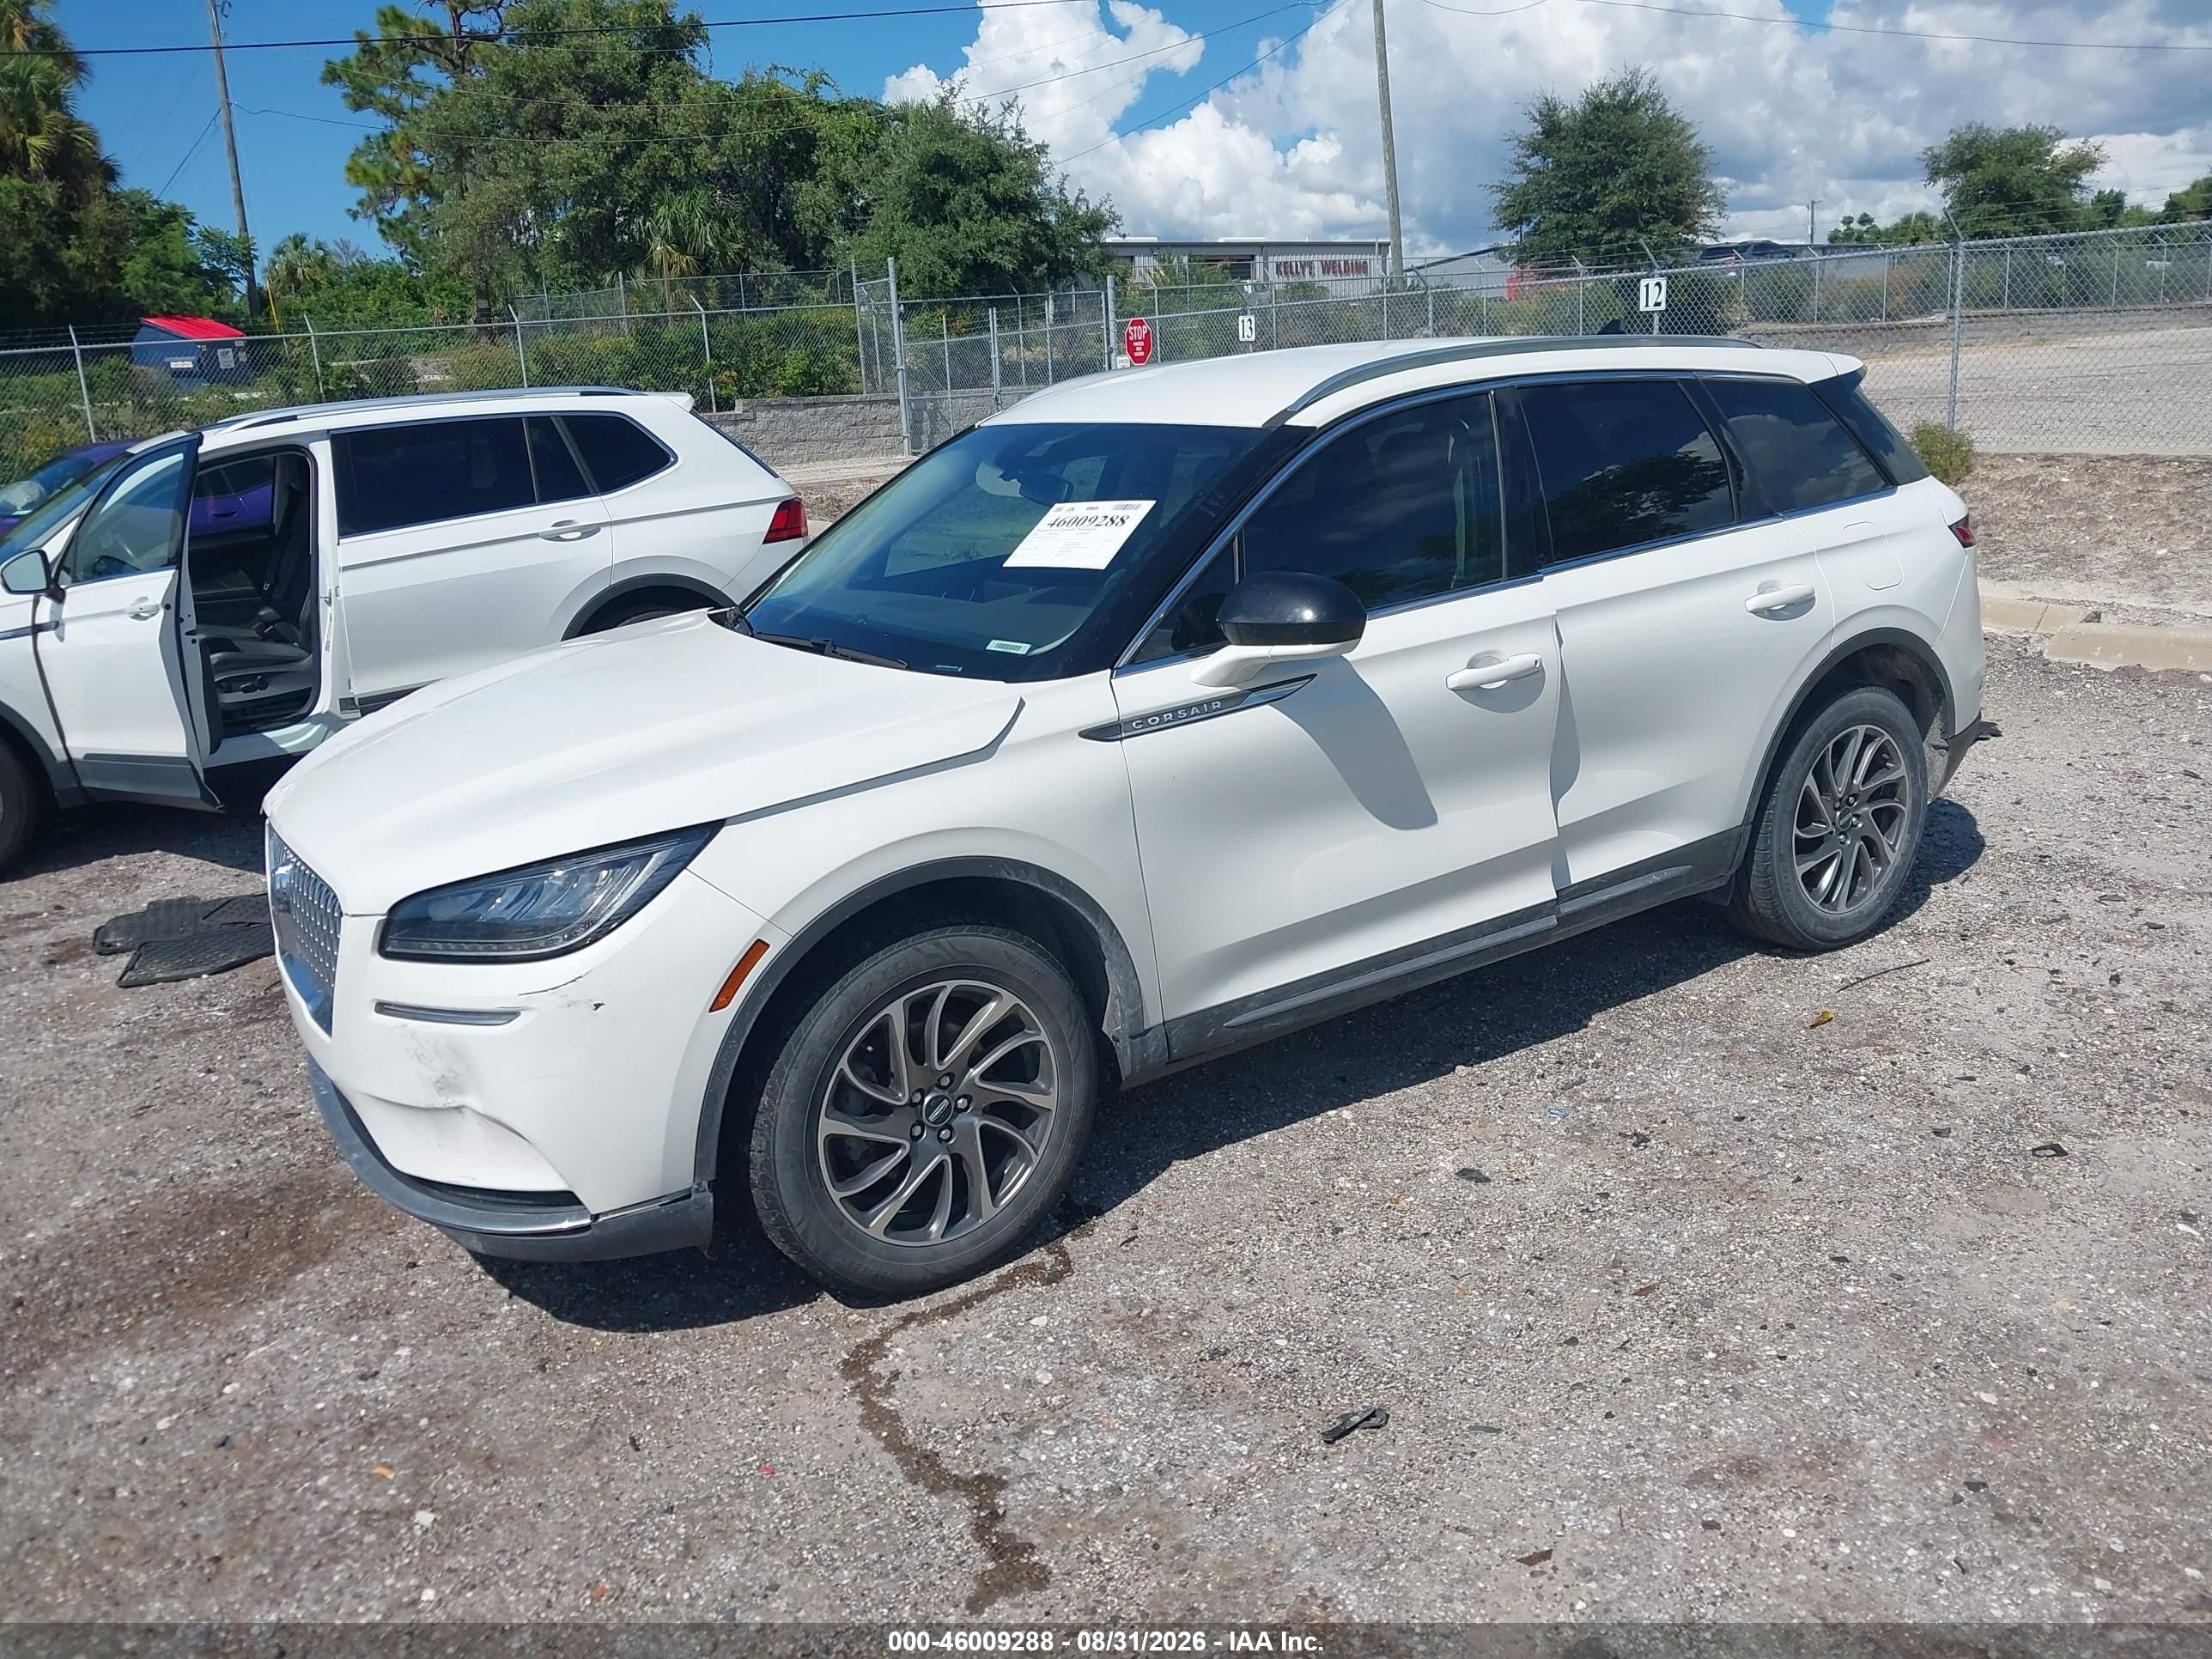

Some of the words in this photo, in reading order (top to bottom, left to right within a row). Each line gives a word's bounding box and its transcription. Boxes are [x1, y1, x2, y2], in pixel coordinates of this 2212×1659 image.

[1322, 260, 1369, 275] WELDING
[1644, 281, 1662, 307] 12
[1128, 325, 1148, 341] STOP
[1241, 318, 1253, 338] 13
[1047, 514, 1130, 528] 46009288
[1132, 700, 1223, 729] CORSAIR
